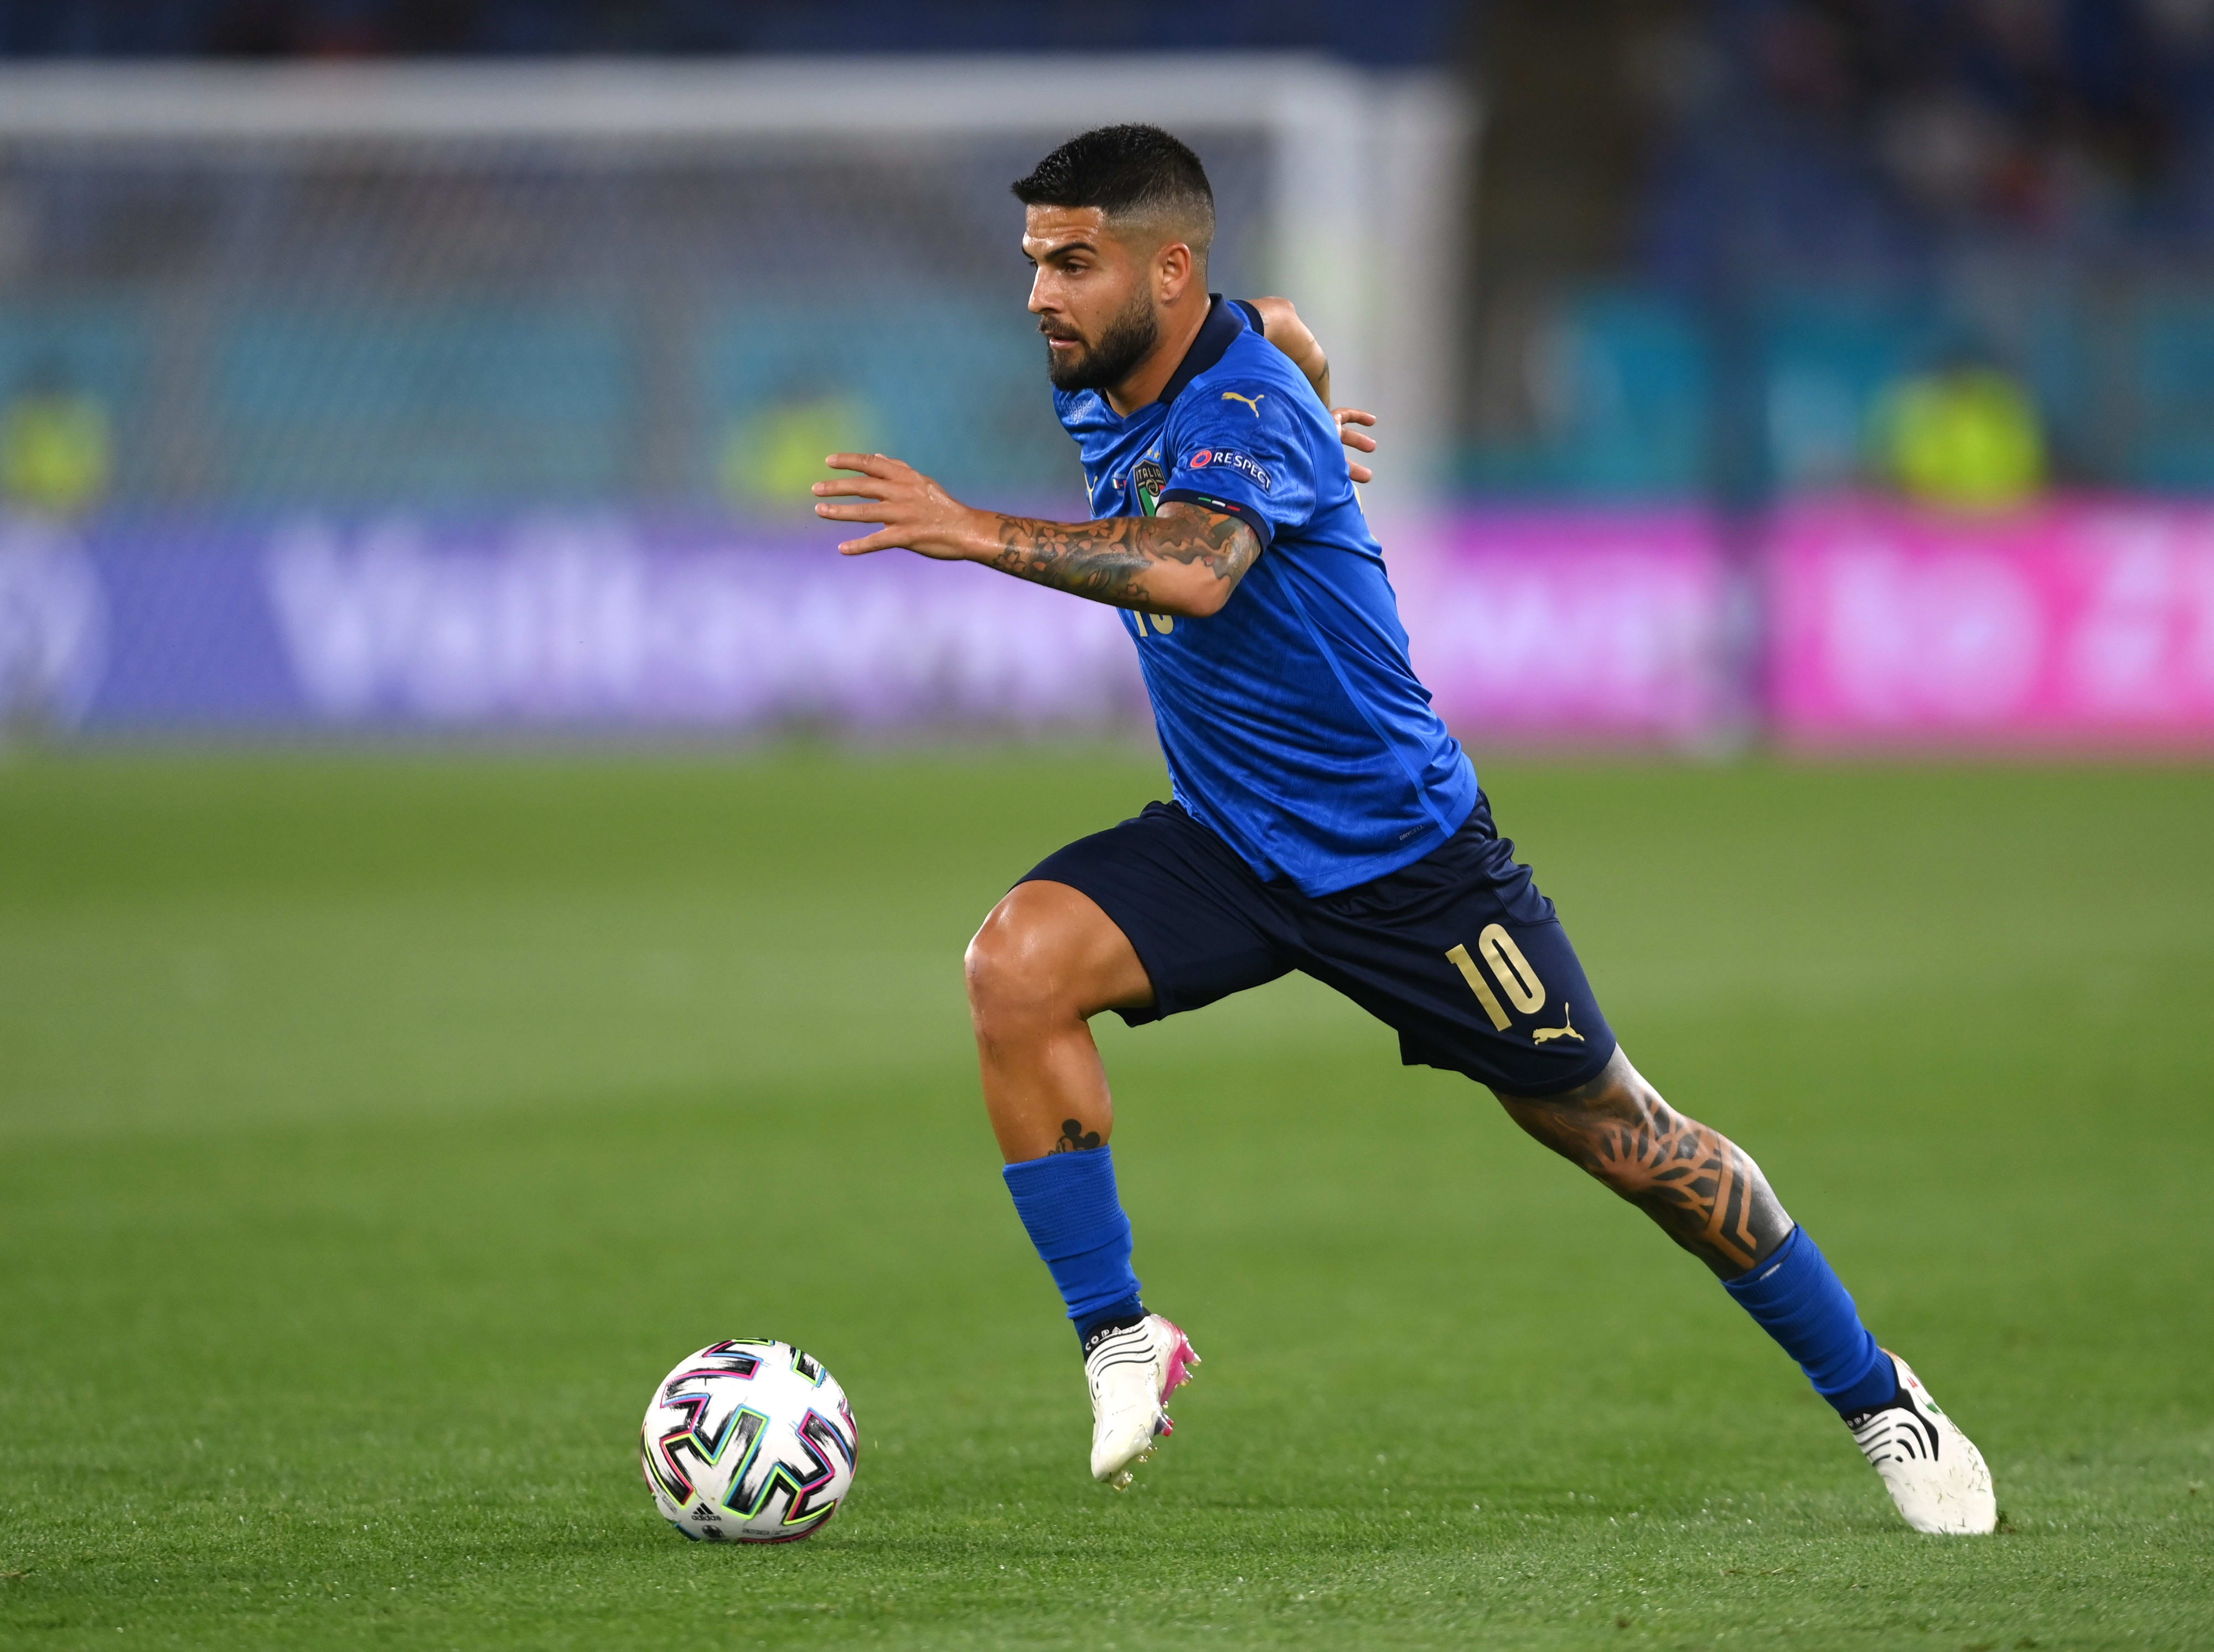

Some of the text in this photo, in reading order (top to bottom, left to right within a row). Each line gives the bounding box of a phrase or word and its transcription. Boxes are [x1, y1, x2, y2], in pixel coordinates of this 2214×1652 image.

[1136, 467, 1163, 481] ITALIA
[1213, 452, 1271, 489] RESPECT
[1399, 825, 1425, 841] DRYCELL
[1445, 923, 1546, 1032] 10
[1085, 1326, 1122, 1351] COPA
